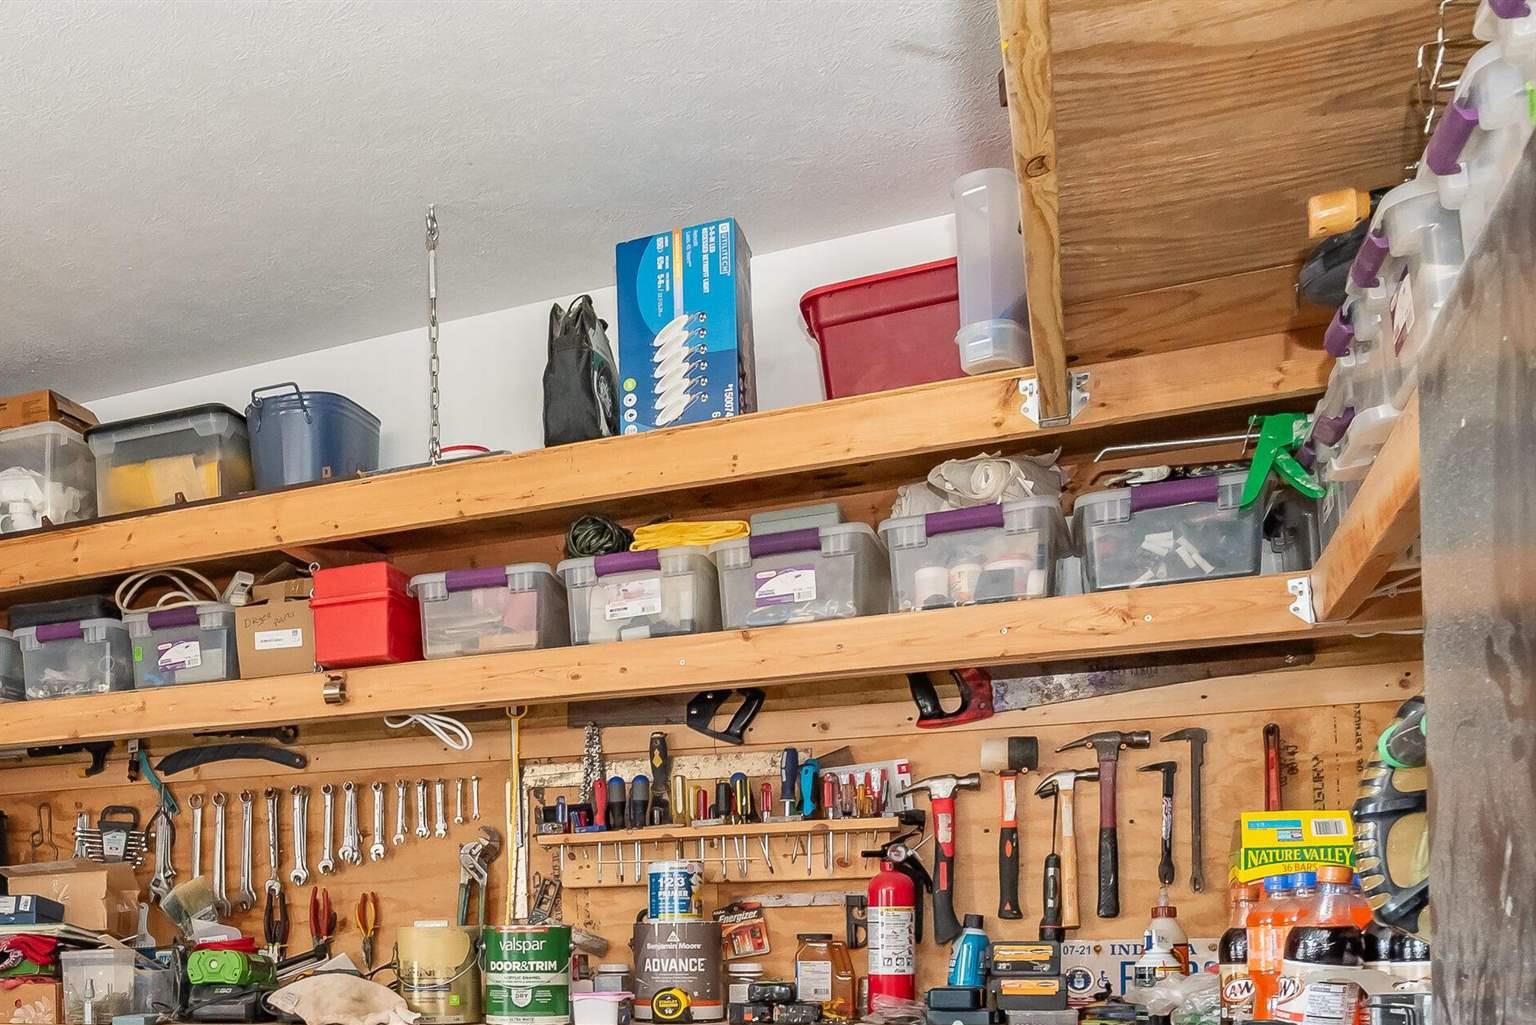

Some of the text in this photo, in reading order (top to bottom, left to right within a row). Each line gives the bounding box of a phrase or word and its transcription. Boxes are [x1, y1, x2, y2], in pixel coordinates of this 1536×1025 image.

[720, 232, 730, 273] UTILITECH
[1247, 847, 1353, 869] NATURE VALLEY
[1282, 863, 1318, 873] 36 BARS
[718, 909, 759, 923] Energizer
[499, 937, 547, 955] valspar
[646, 943, 677, 951] Benjamin
[1063, 945, 1092, 955] 07-21
[490, 960, 557, 971] DOOR&TRIM
[644, 957, 706, 973] ADVANCE
